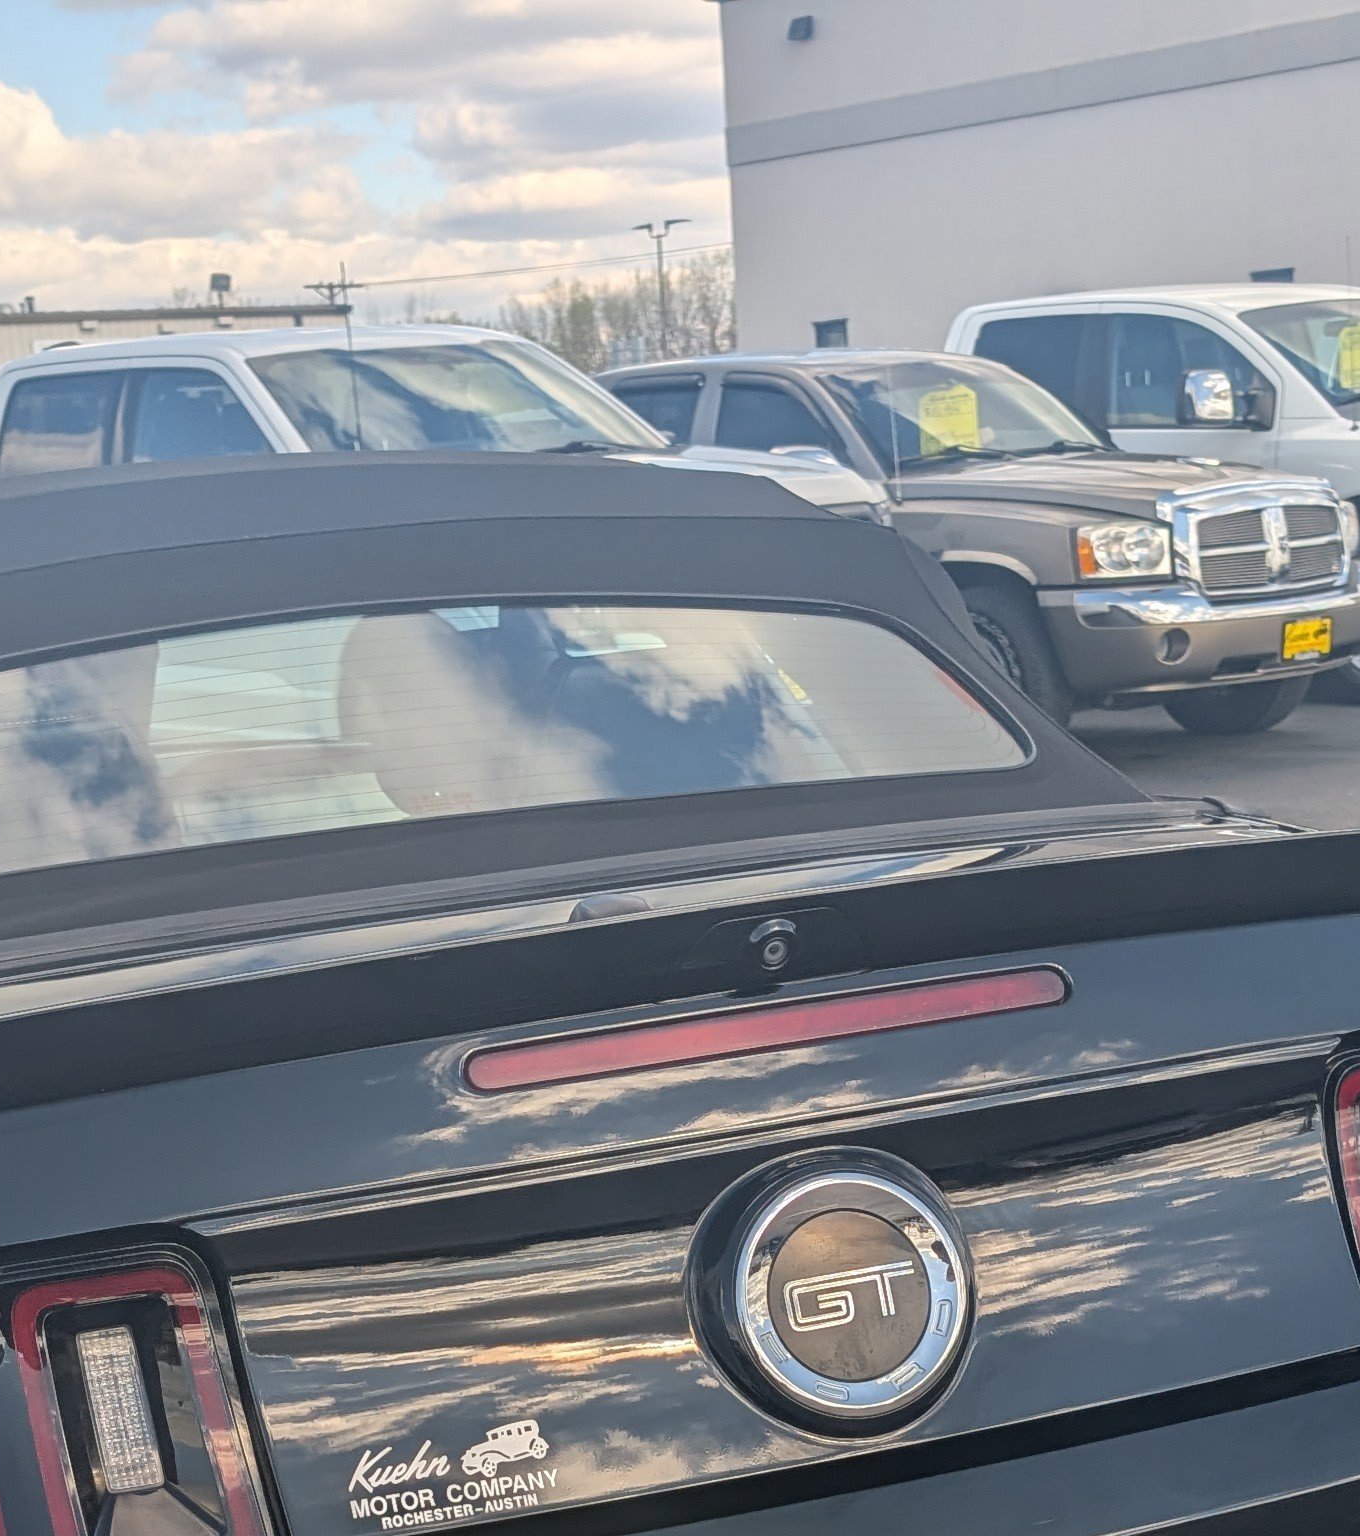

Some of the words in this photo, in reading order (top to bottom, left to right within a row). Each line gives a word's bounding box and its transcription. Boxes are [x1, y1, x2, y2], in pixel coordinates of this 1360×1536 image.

[783, 1260, 915, 1332] GT
[348, 1439, 451, 1493] Kuehn
[349, 1487, 437, 1519] MOTOR
[446, 1468, 558, 1504] COMPANY
